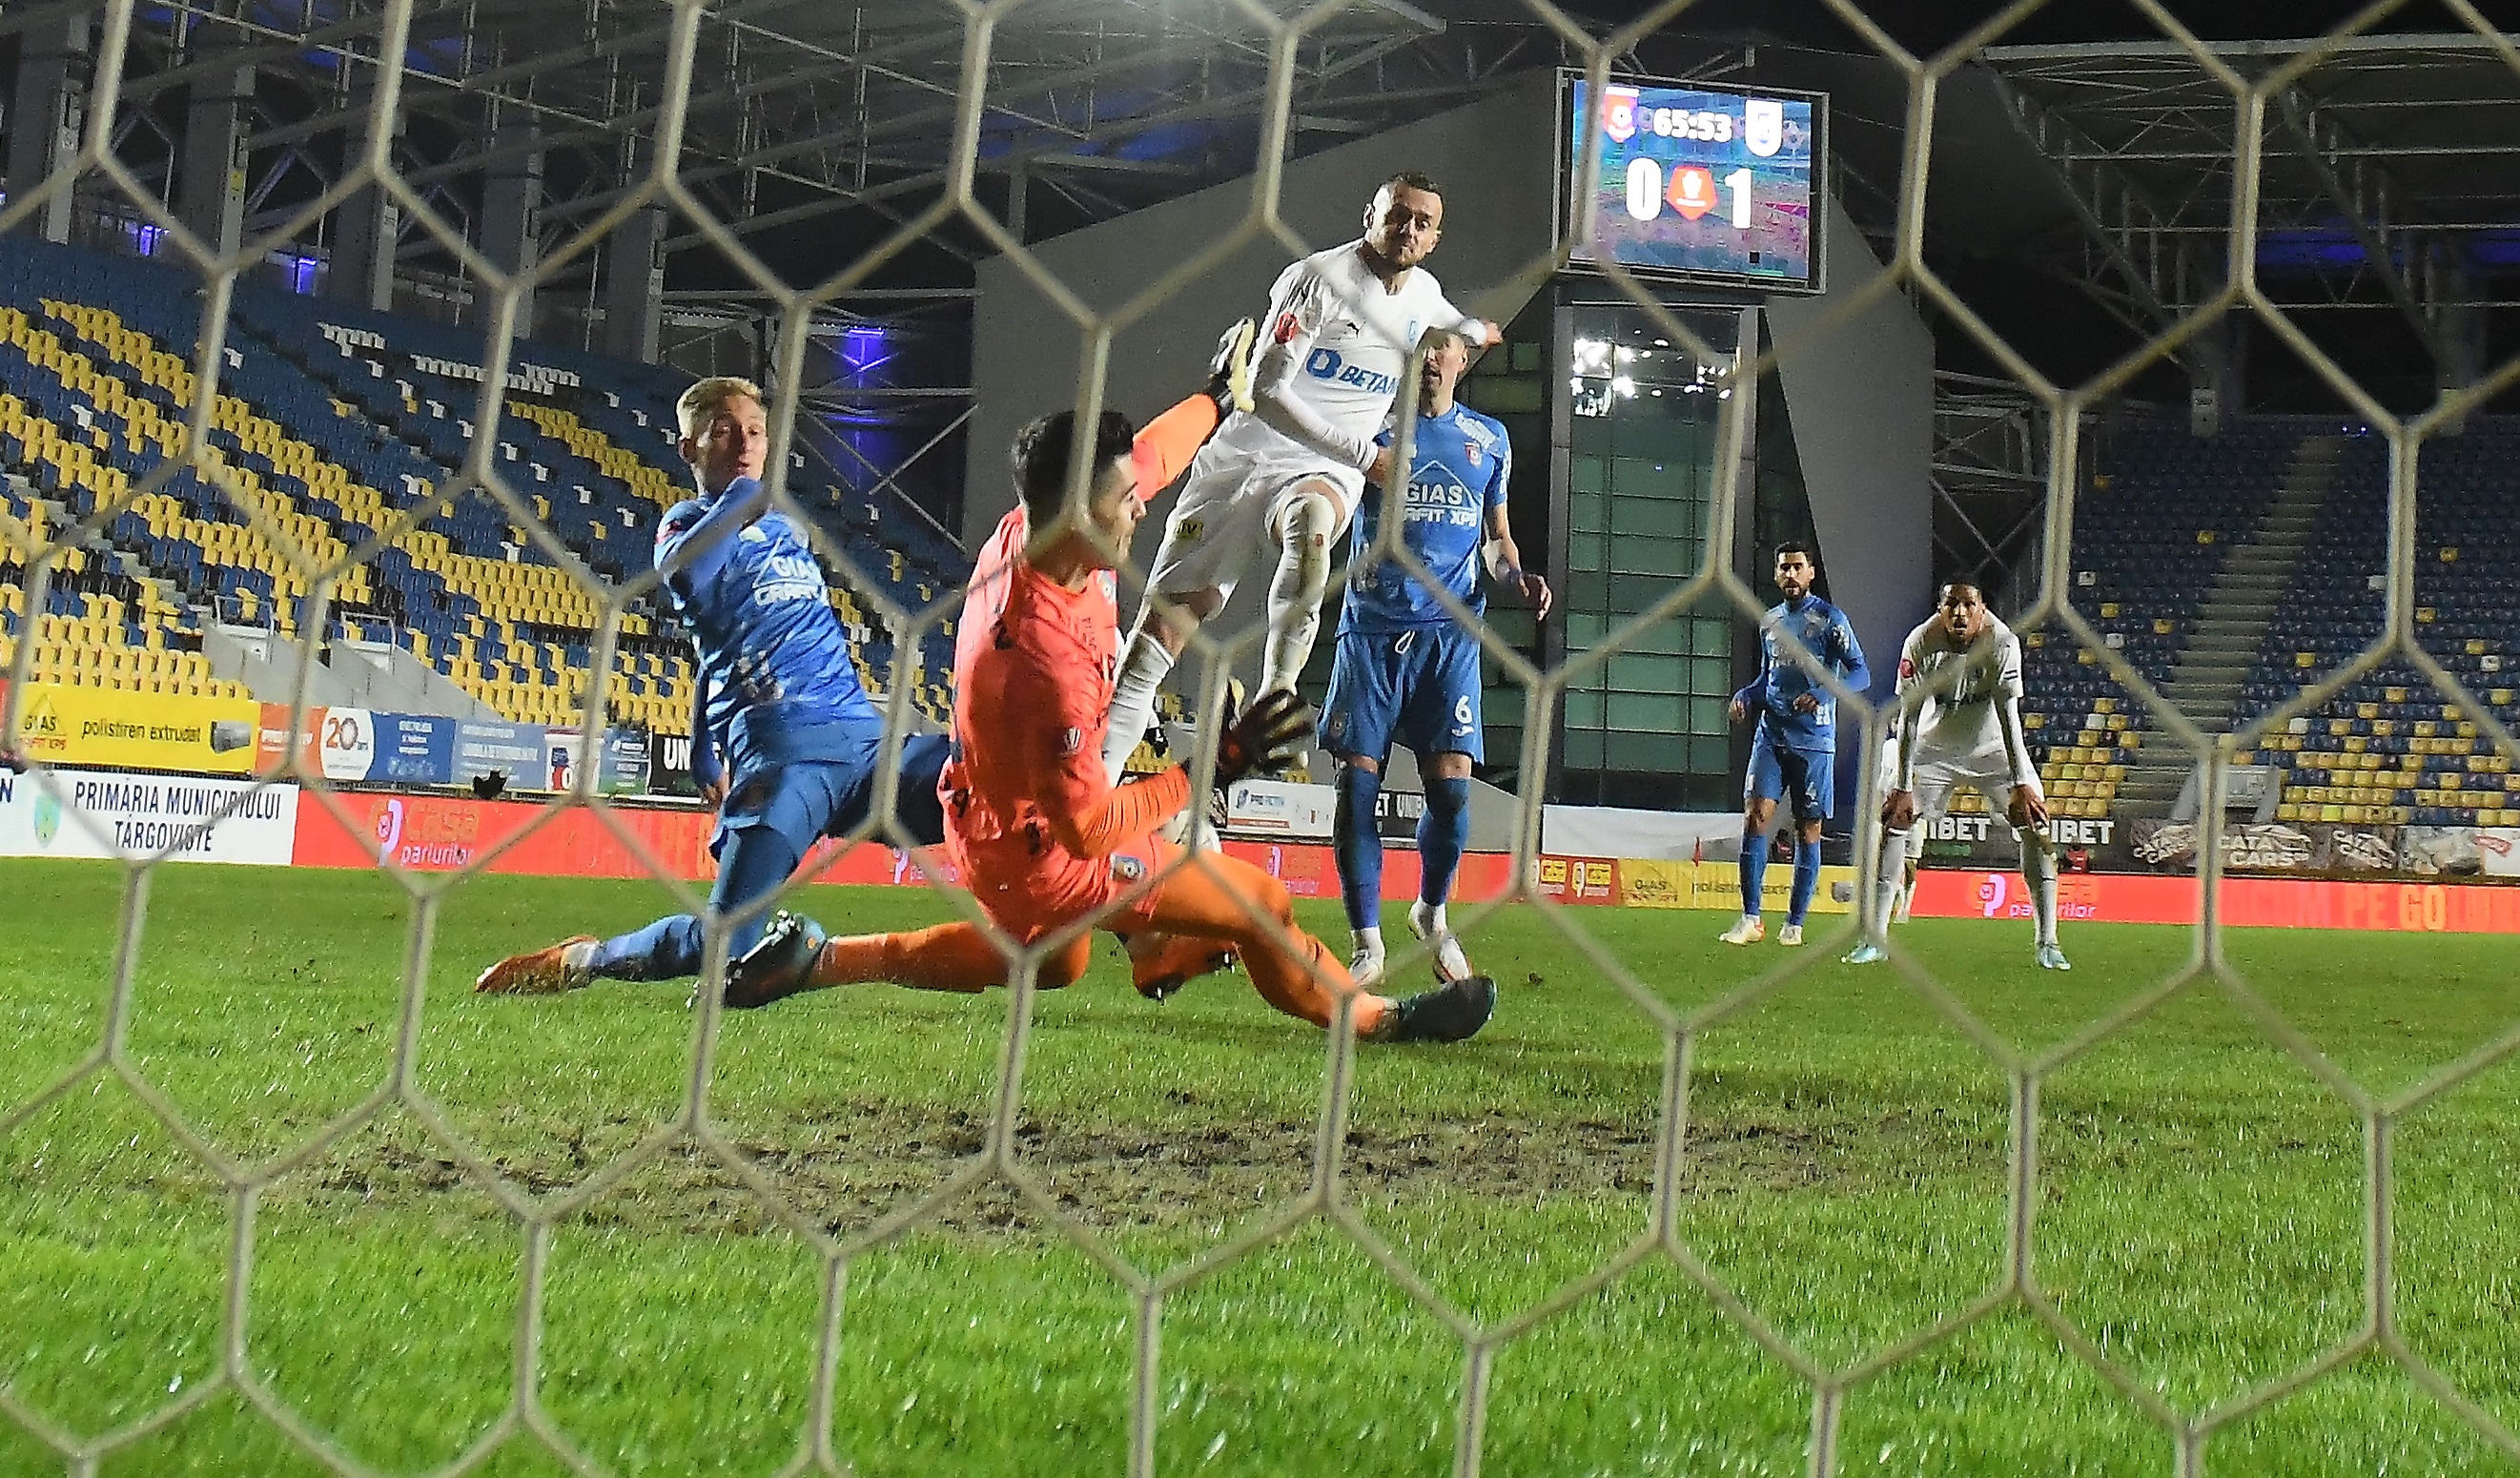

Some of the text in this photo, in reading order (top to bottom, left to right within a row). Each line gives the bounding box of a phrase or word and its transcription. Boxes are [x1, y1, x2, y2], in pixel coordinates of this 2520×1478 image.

[1652, 108, 1733, 143] 65:53
[1626, 157, 1752, 229] 0 1
[1405, 483, 1464, 505] GIAS
[1454, 695, 1473, 725] 6
[81, 719, 201, 743] polistiren extrudat
[325, 716, 359, 751] 20
[165, 786, 281, 820] MUNICIPIULUI
[1928, 817, 1992, 842] IBET
[401, 844, 474, 866] pariurilor
[2230, 851, 2294, 867] CARS
